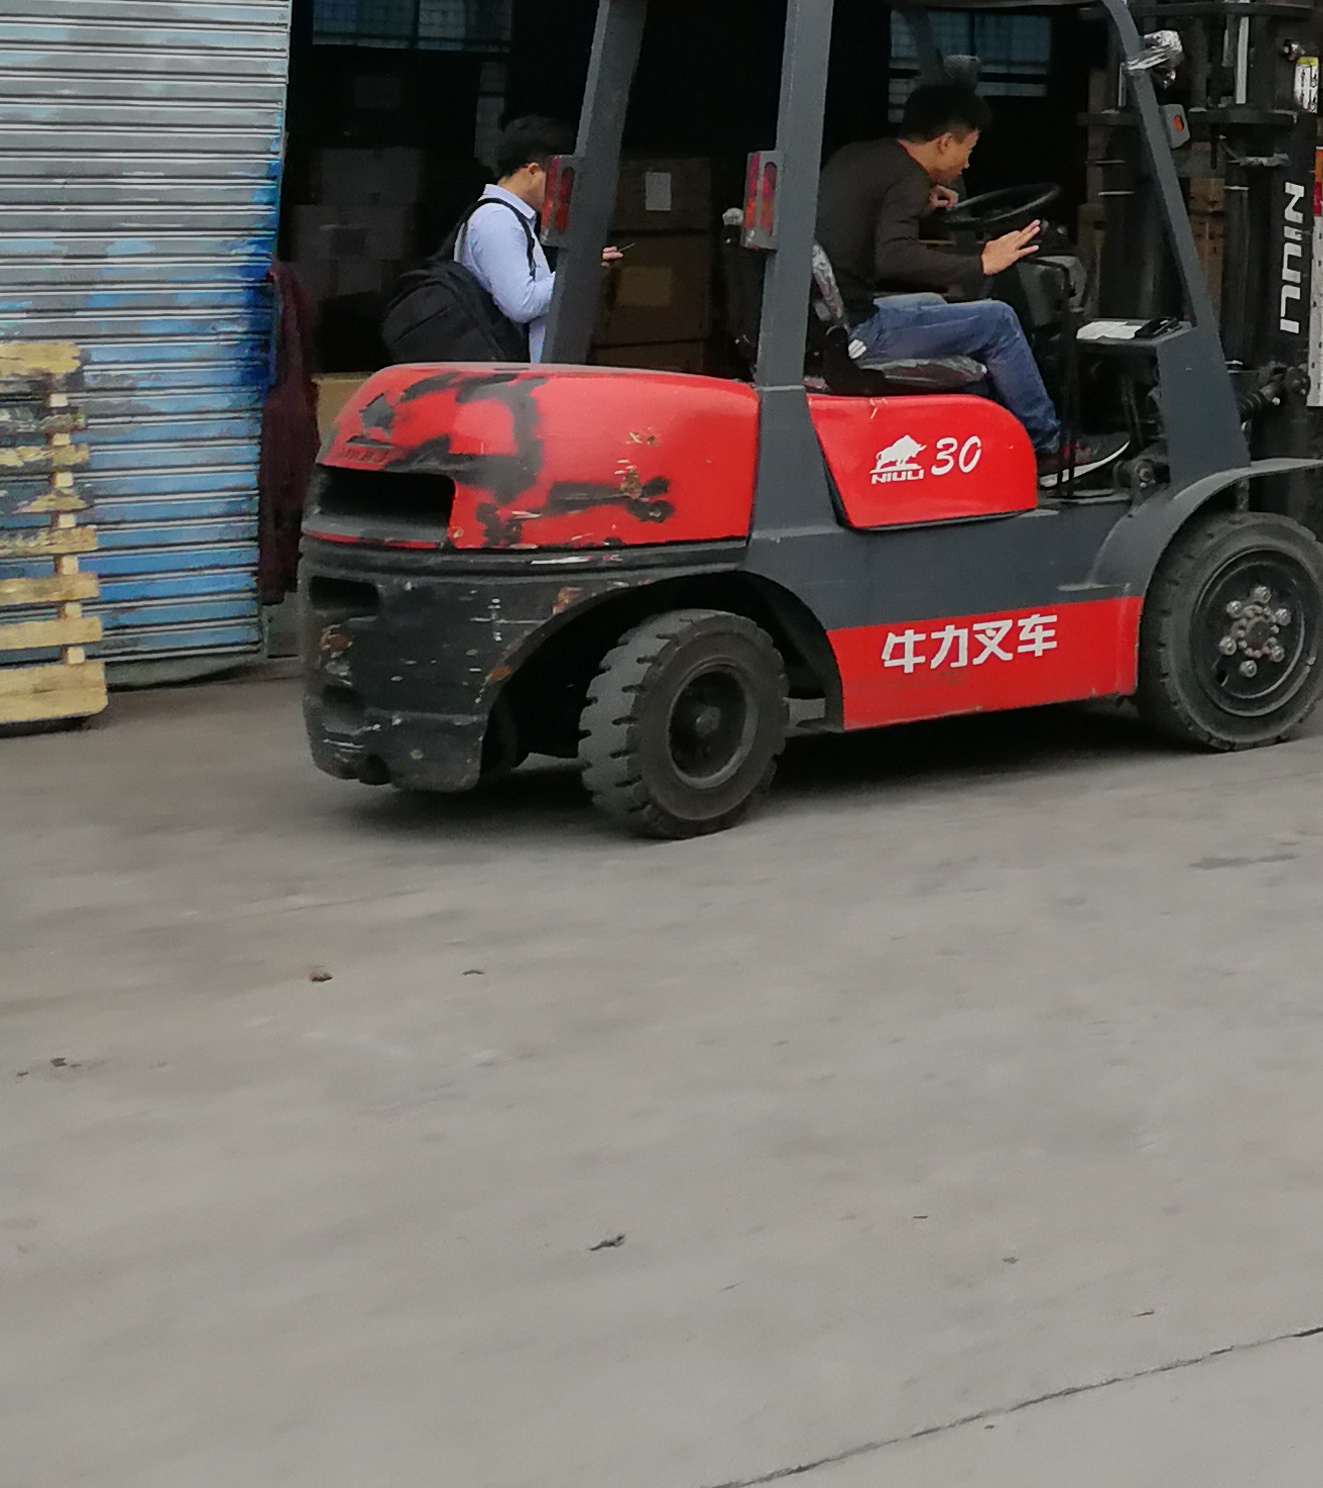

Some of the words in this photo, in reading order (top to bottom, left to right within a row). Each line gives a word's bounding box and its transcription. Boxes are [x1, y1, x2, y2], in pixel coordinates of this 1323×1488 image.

[1280, 181, 1305, 334] NIULI
[871, 469, 925, 485] NIULI
[931, 435, 982, 476] 30
[881, 613, 1058, 674] 牛力叉车
